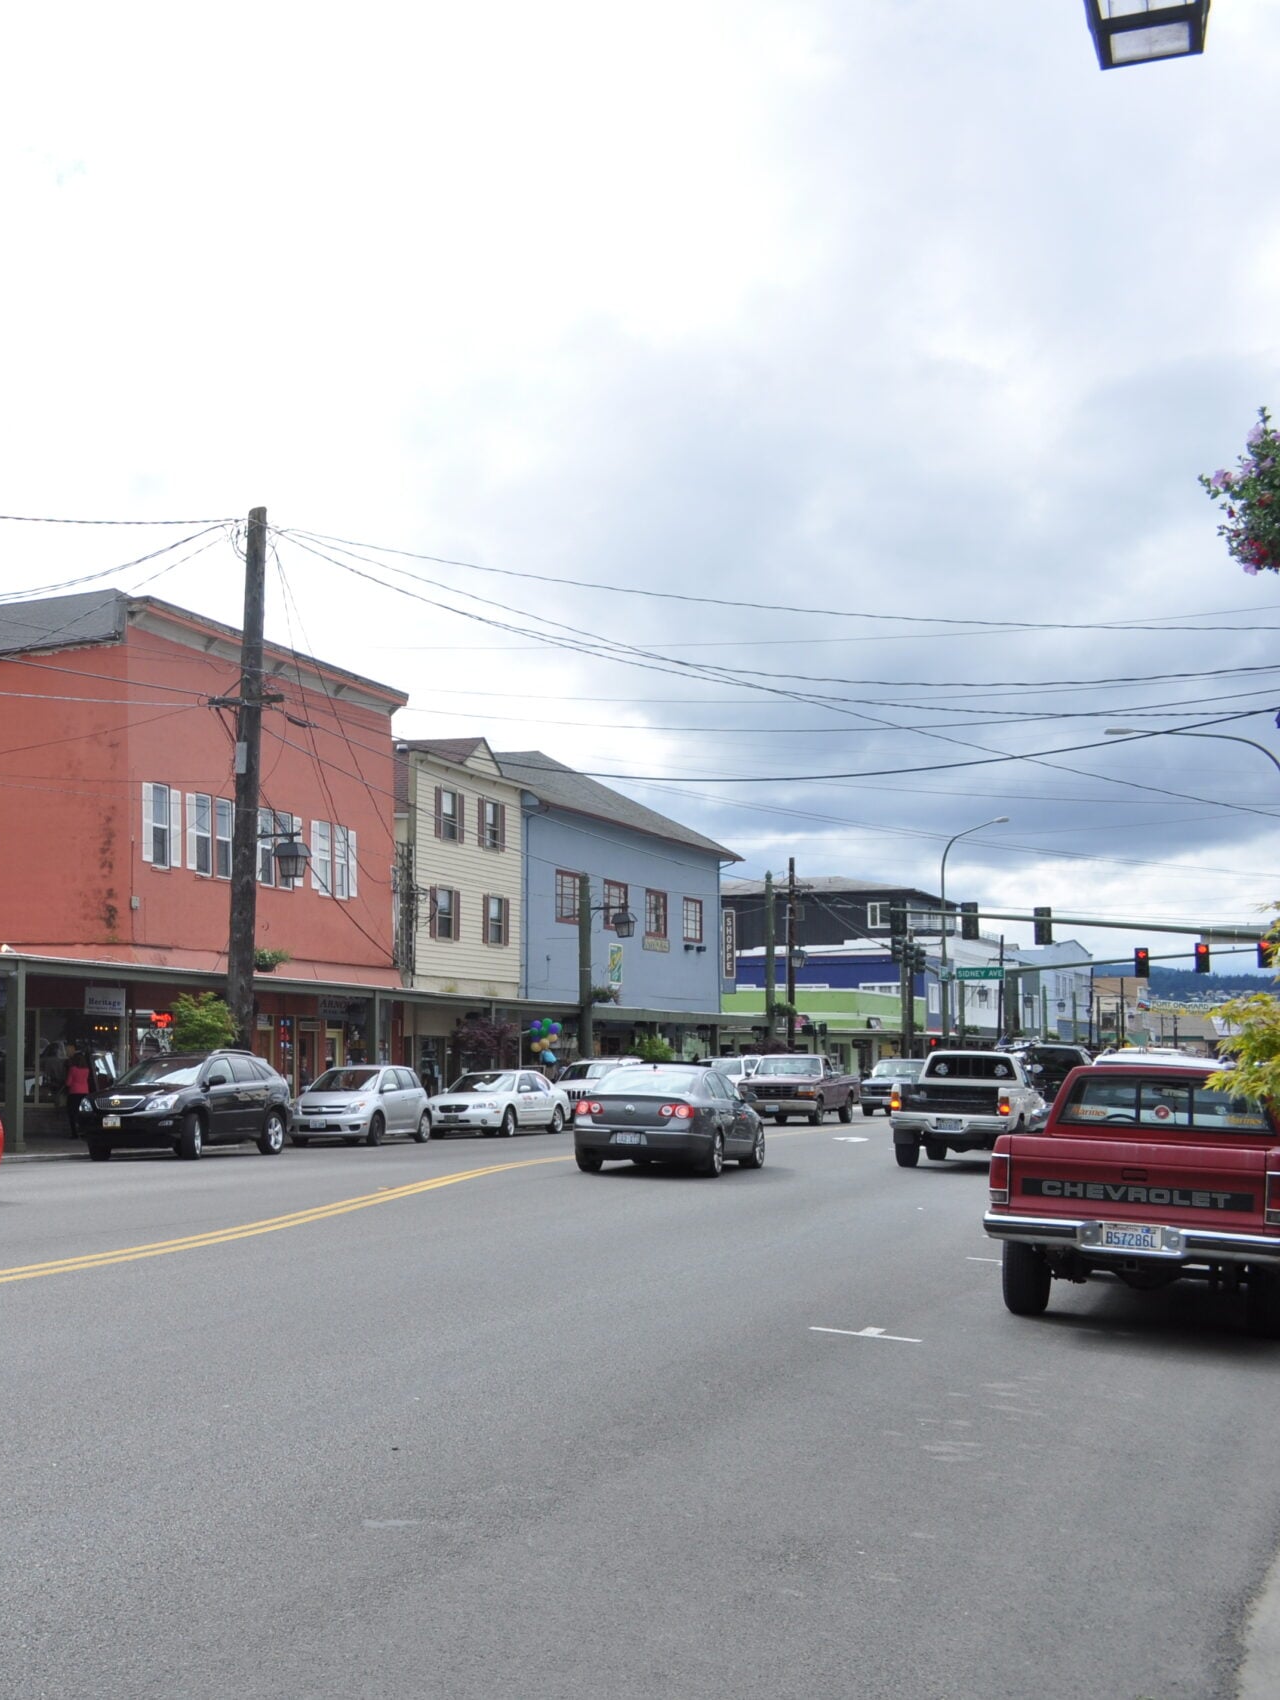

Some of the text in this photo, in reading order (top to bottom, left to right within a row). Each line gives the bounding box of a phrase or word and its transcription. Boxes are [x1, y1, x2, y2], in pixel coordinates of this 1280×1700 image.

[725, 917, 734, 971] SHOPPE
[988, 969, 1003, 977] AVE
[88, 997, 122, 1007] Heritage
[1151, 1000, 1209, 1010] PORT ORCHARD
[1071, 1104, 1106, 1117] Marines
[1040, 1180, 1232, 1209] CHEVROLET
[1106, 1231, 1157, 1248] B57286L
